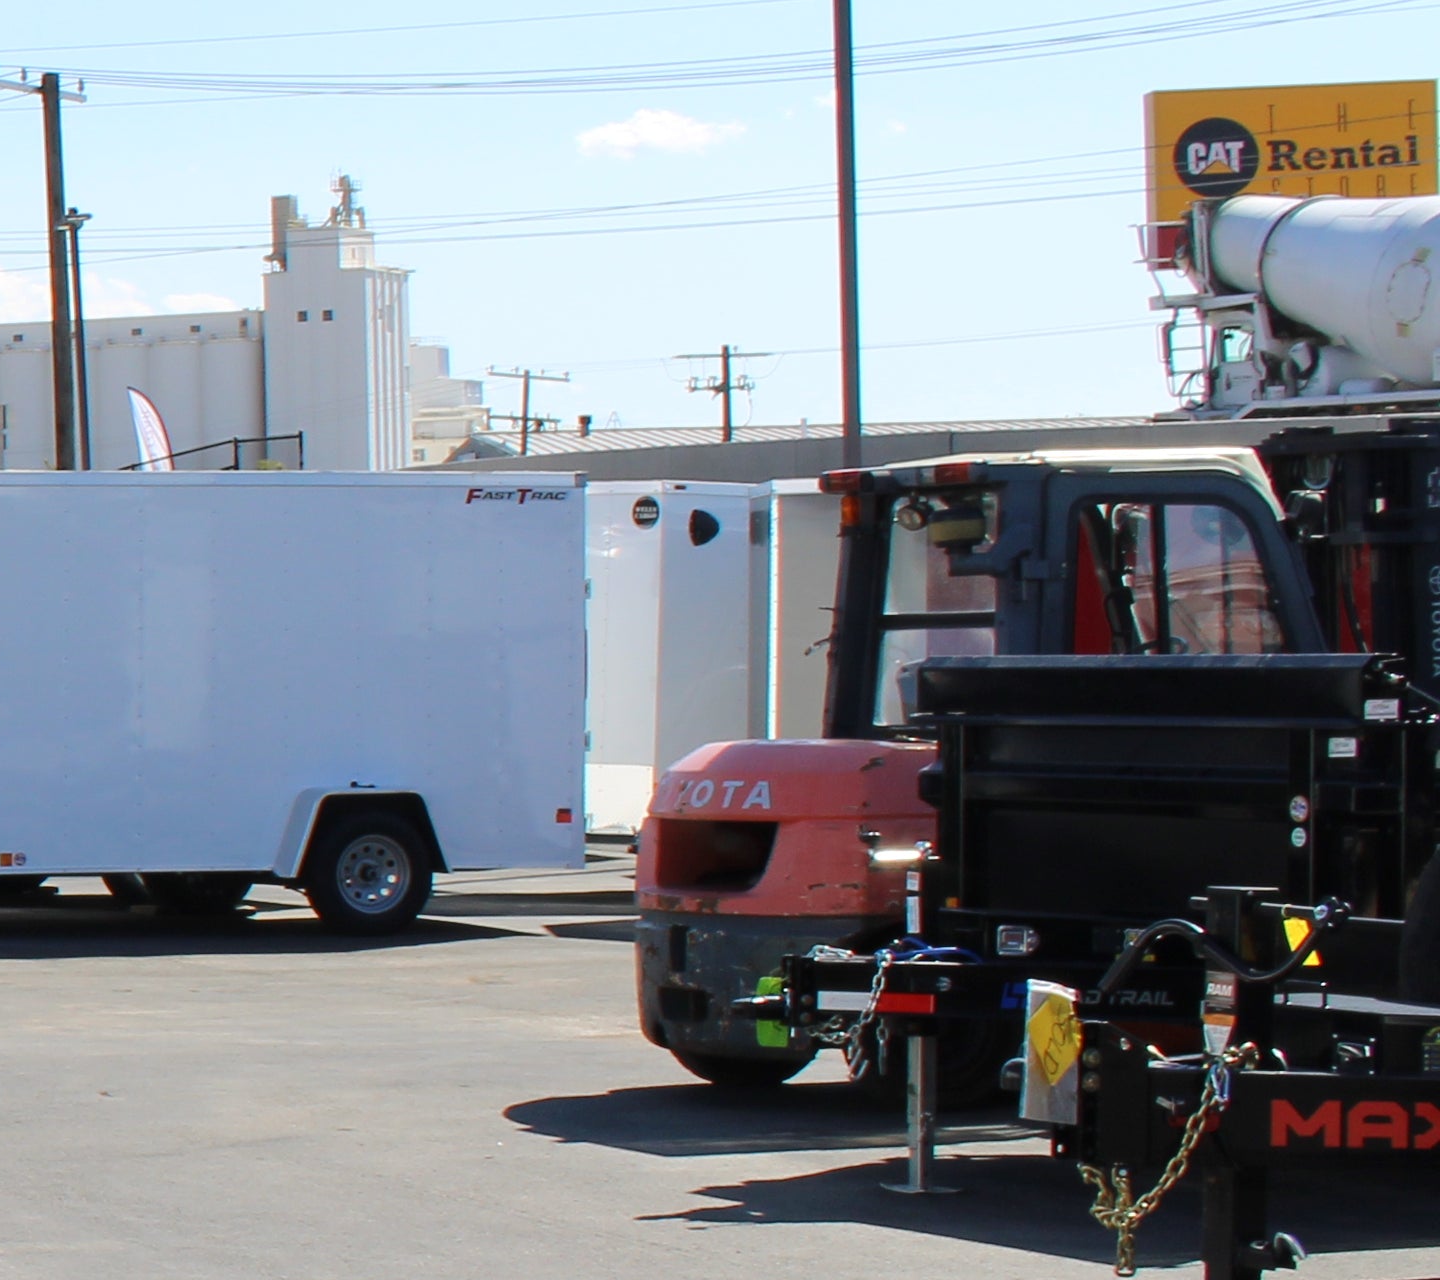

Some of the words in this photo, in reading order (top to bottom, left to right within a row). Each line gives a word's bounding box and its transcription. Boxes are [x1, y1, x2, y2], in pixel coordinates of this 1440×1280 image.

[1266, 98, 1417, 134] THE
[1187, 140, 1245, 176] CAT
[1266, 134, 1421, 171] Rental
